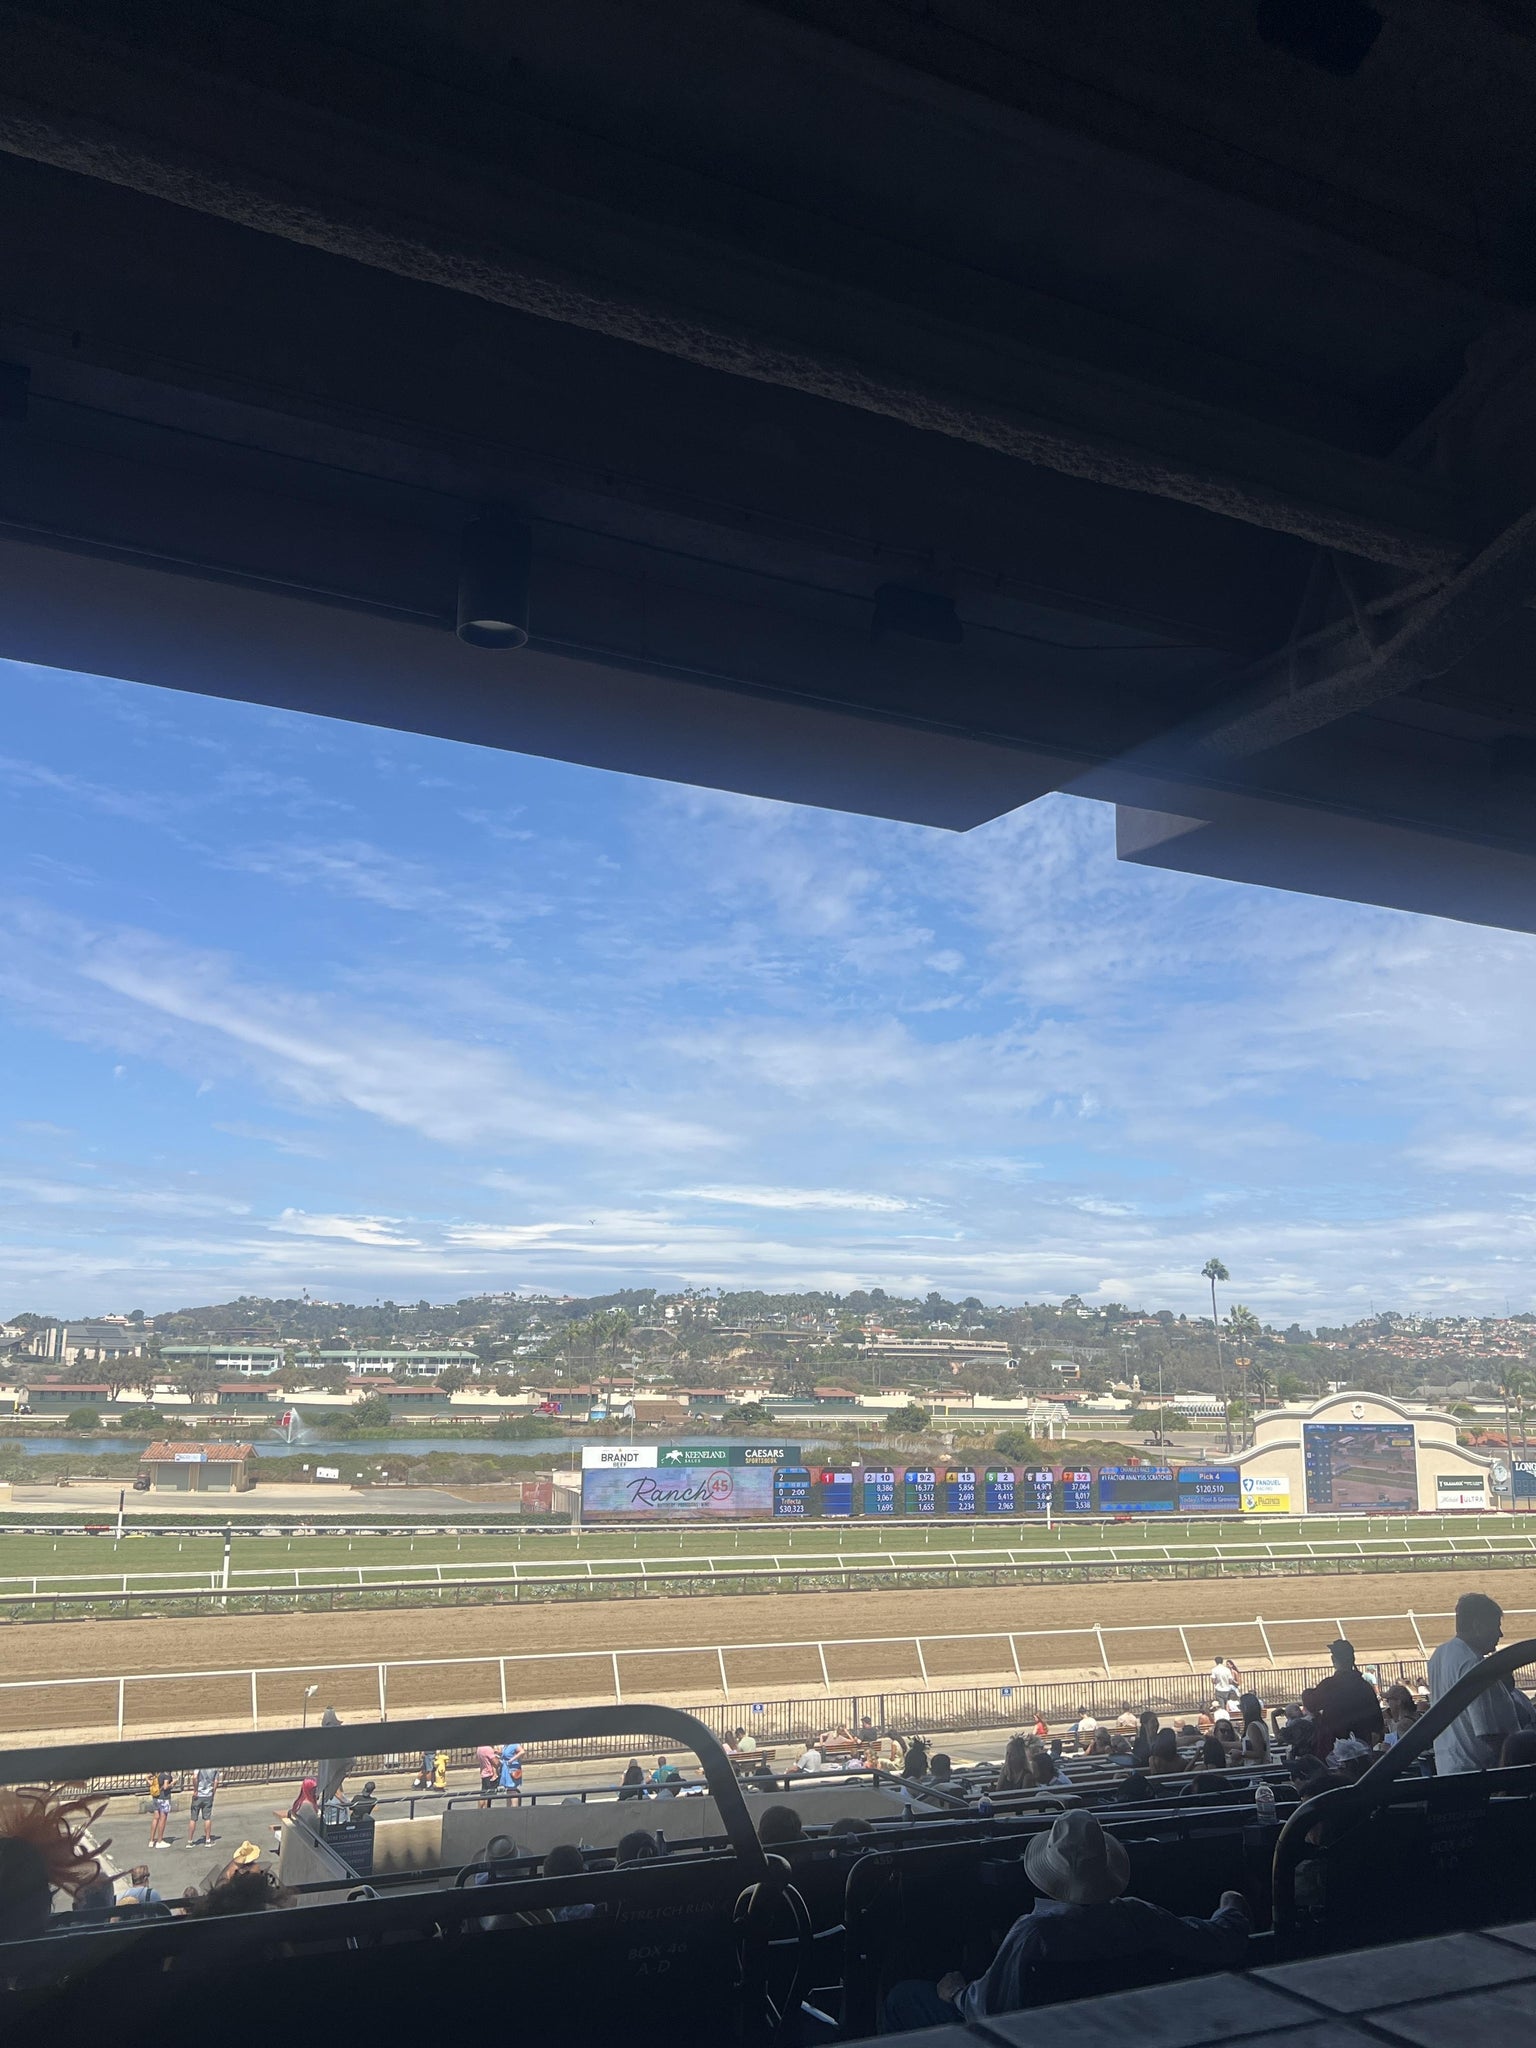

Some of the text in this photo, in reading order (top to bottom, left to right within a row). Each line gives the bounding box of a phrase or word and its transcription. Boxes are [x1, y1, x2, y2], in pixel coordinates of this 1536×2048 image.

[601, 1453, 639, 1462] BRANDT
[685, 1451, 725, 1460] KEENELAND
[745, 1449, 784, 1458] CAESARS
[779, 1473, 784, 1482] 2
[825, 1474, 830, 1483] 1
[867, 1474, 891, 1482] 2 10
[920, 1474, 932, 1482] 9/2
[948, 1473, 972, 1481] 4 15
[988, 1473, 1009, 1481] 5 2
[1027, 1473, 1047, 1481] 6 5
[1065, 1473, 1088, 1481] 7 3/2
[1147, 1473, 1173, 1481] SCRATCHED
[1199, 1472, 1220, 1480] Pick 4
[711, 1479, 729, 1492] 45
[915, 1484, 935, 1493] 16,377
[959, 1483, 975, 1492] 5,856
[994, 1483, 1014, 1491] 28,355
[1071, 1482, 1090, 1491] 37,064
[1195, 1484, 1225, 1494] $120,510
[627, 1476, 713, 1507] Ranch
[778, 1488, 806, 1496] 0 2:00
[876, 1494, 894, 1502] 3,067
[918, 1494, 935, 1502] 3,512
[959, 1492, 975, 1501] 2,693
[998, 1492, 1014, 1501] 6,415
[1074, 1492, 1090, 1501] 8,017
[1464, 1495, 1484, 1503] ULTRA
[779, 1505, 805, 1514] $30,323
[876, 1503, 894, 1512] 1,695
[918, 1503, 935, 1511] 1,655
[959, 1502, 975, 1511] 2,234
[998, 1502, 1014, 1511] 2,965
[622, 1903, 683, 1921] STRETCH
[628, 1944, 662, 1960] BOX
